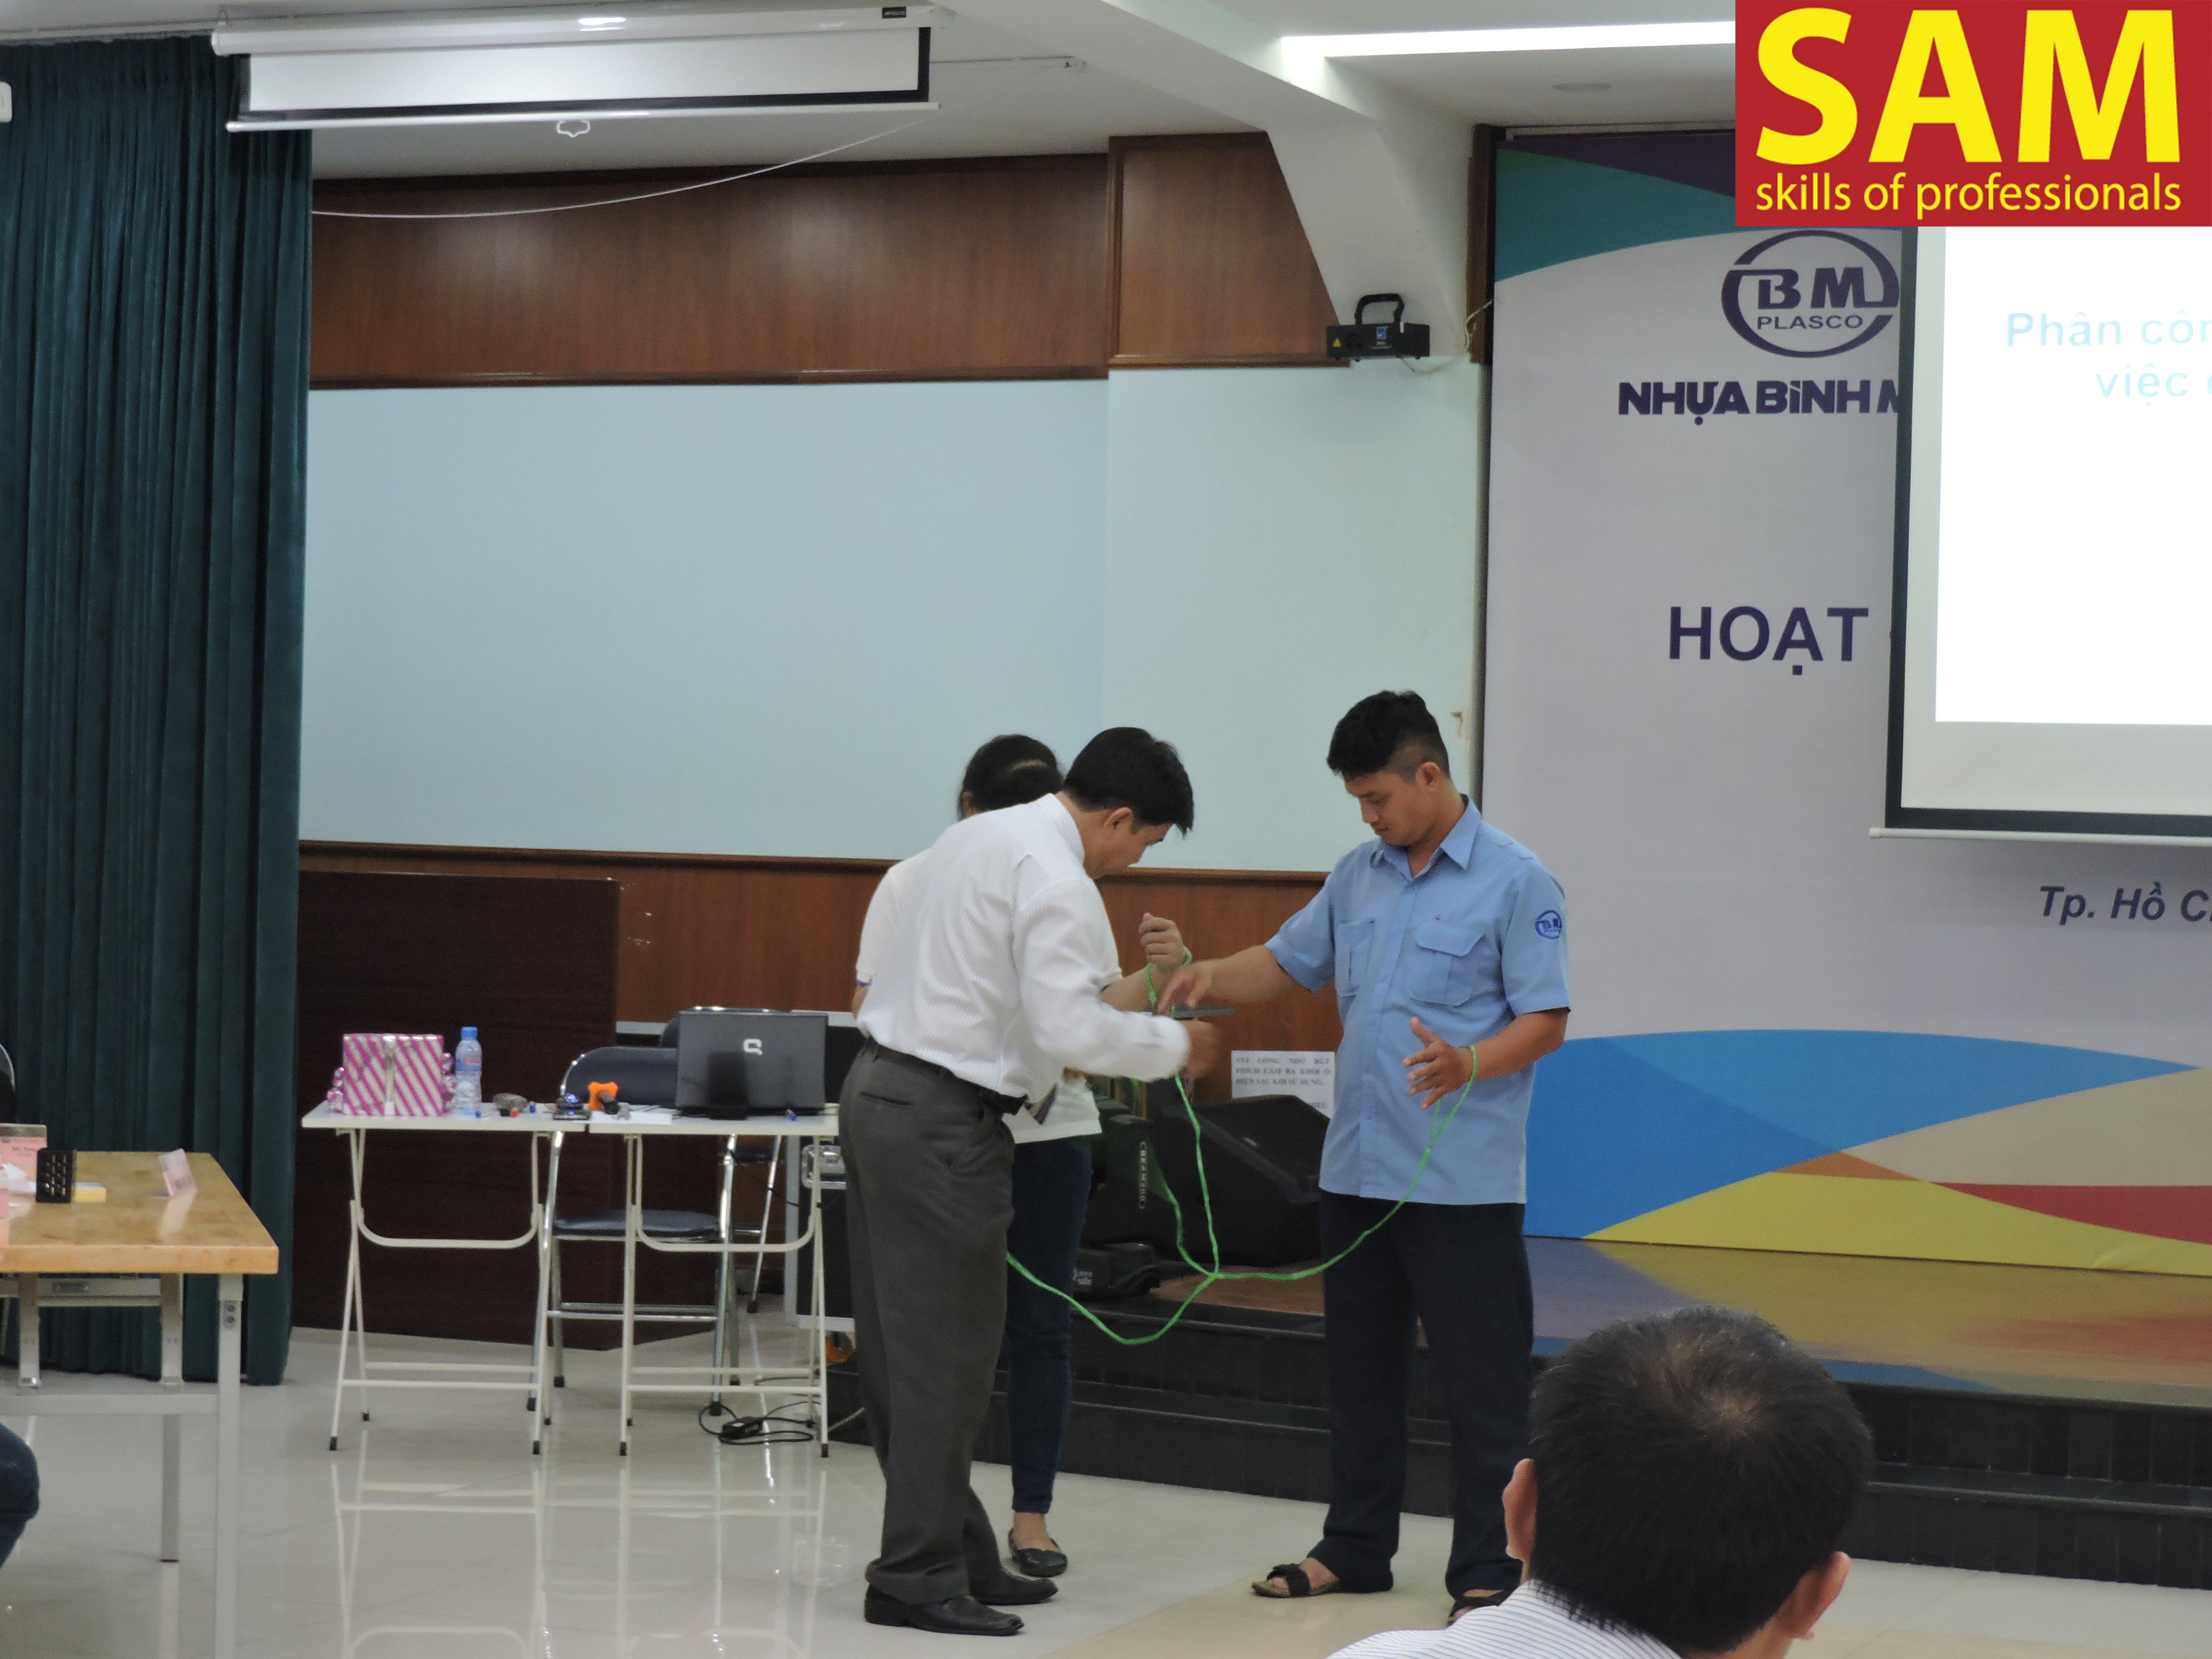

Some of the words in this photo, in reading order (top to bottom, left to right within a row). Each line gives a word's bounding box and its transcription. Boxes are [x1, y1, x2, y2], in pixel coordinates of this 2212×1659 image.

[1757, 315, 1863, 329] PLASCO
[2007, 311, 2121, 348] Phân
[1618, 381, 1750, 425] NHỰA
[2095, 362, 2188, 407] việc
[1669, 606, 1869, 675] HOẠT
[2040, 885, 2095, 926] Tp.
[2110, 881, 2165, 921] Hồ
[2180, 890, 2212, 922] C
